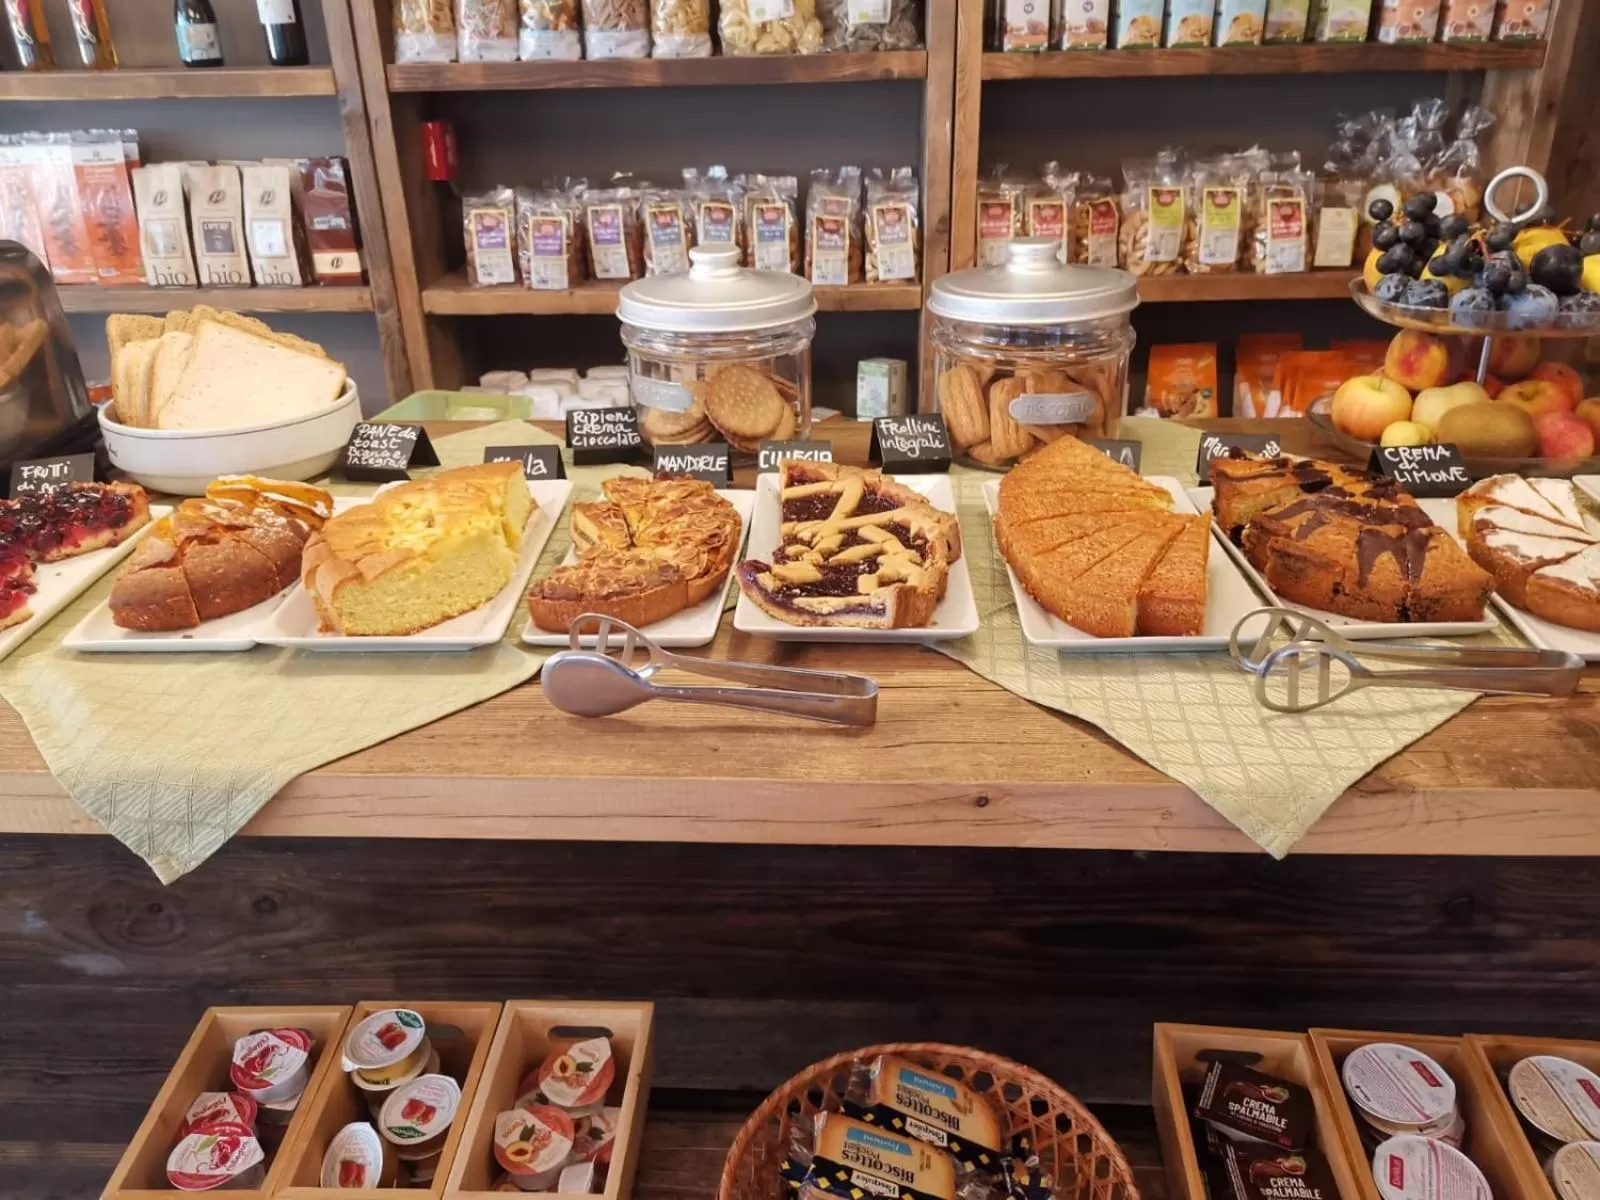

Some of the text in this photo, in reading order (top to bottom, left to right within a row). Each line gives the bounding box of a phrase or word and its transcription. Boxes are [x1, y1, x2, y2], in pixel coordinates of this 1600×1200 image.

[153, 266, 189, 285] bio
[207, 265, 242, 285] bio
[261, 266, 294, 285] bio
[573, 410, 636, 426] Ripieni
[353, 438, 401, 449] toast
[881, 433, 945, 458] integrali
[1384, 445, 1451, 462] CREMA
[656, 455, 728, 473] MANDORLE
[1394, 467, 1468, 484] LIMONE
[1243, 1097, 1276, 1115] CREMA
[1228, 1102, 1288, 1129] SPALMABILE
[842, 1150, 914, 1184] Biscottes
[1270, 1177, 1306, 1188] CREMA
